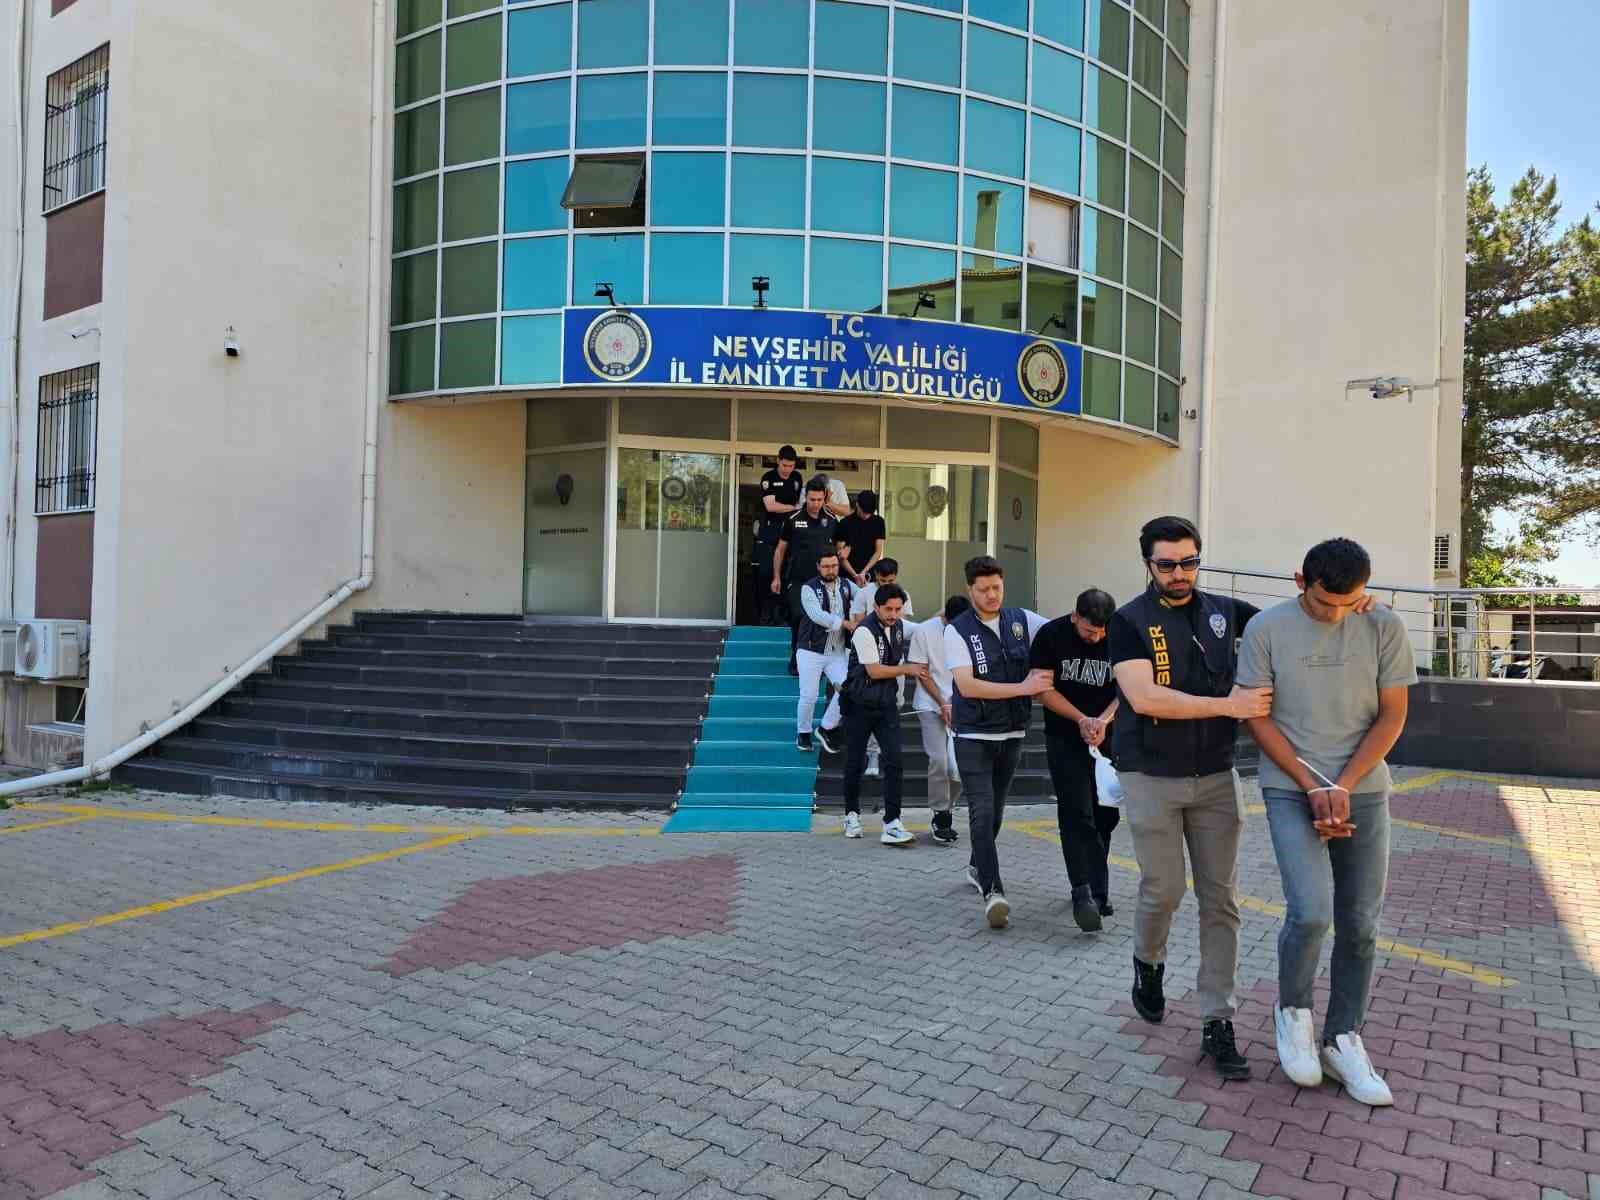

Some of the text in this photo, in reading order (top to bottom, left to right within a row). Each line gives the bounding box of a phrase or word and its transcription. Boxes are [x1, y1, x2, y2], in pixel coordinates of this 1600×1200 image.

[825, 314, 871, 338] T.C.
[713, 335, 967, 372] NEVŞEHİR VALİLİĞİ
[670, 356, 1001, 401] İL EMNİYET MÜDÜRLÜĞÜ
